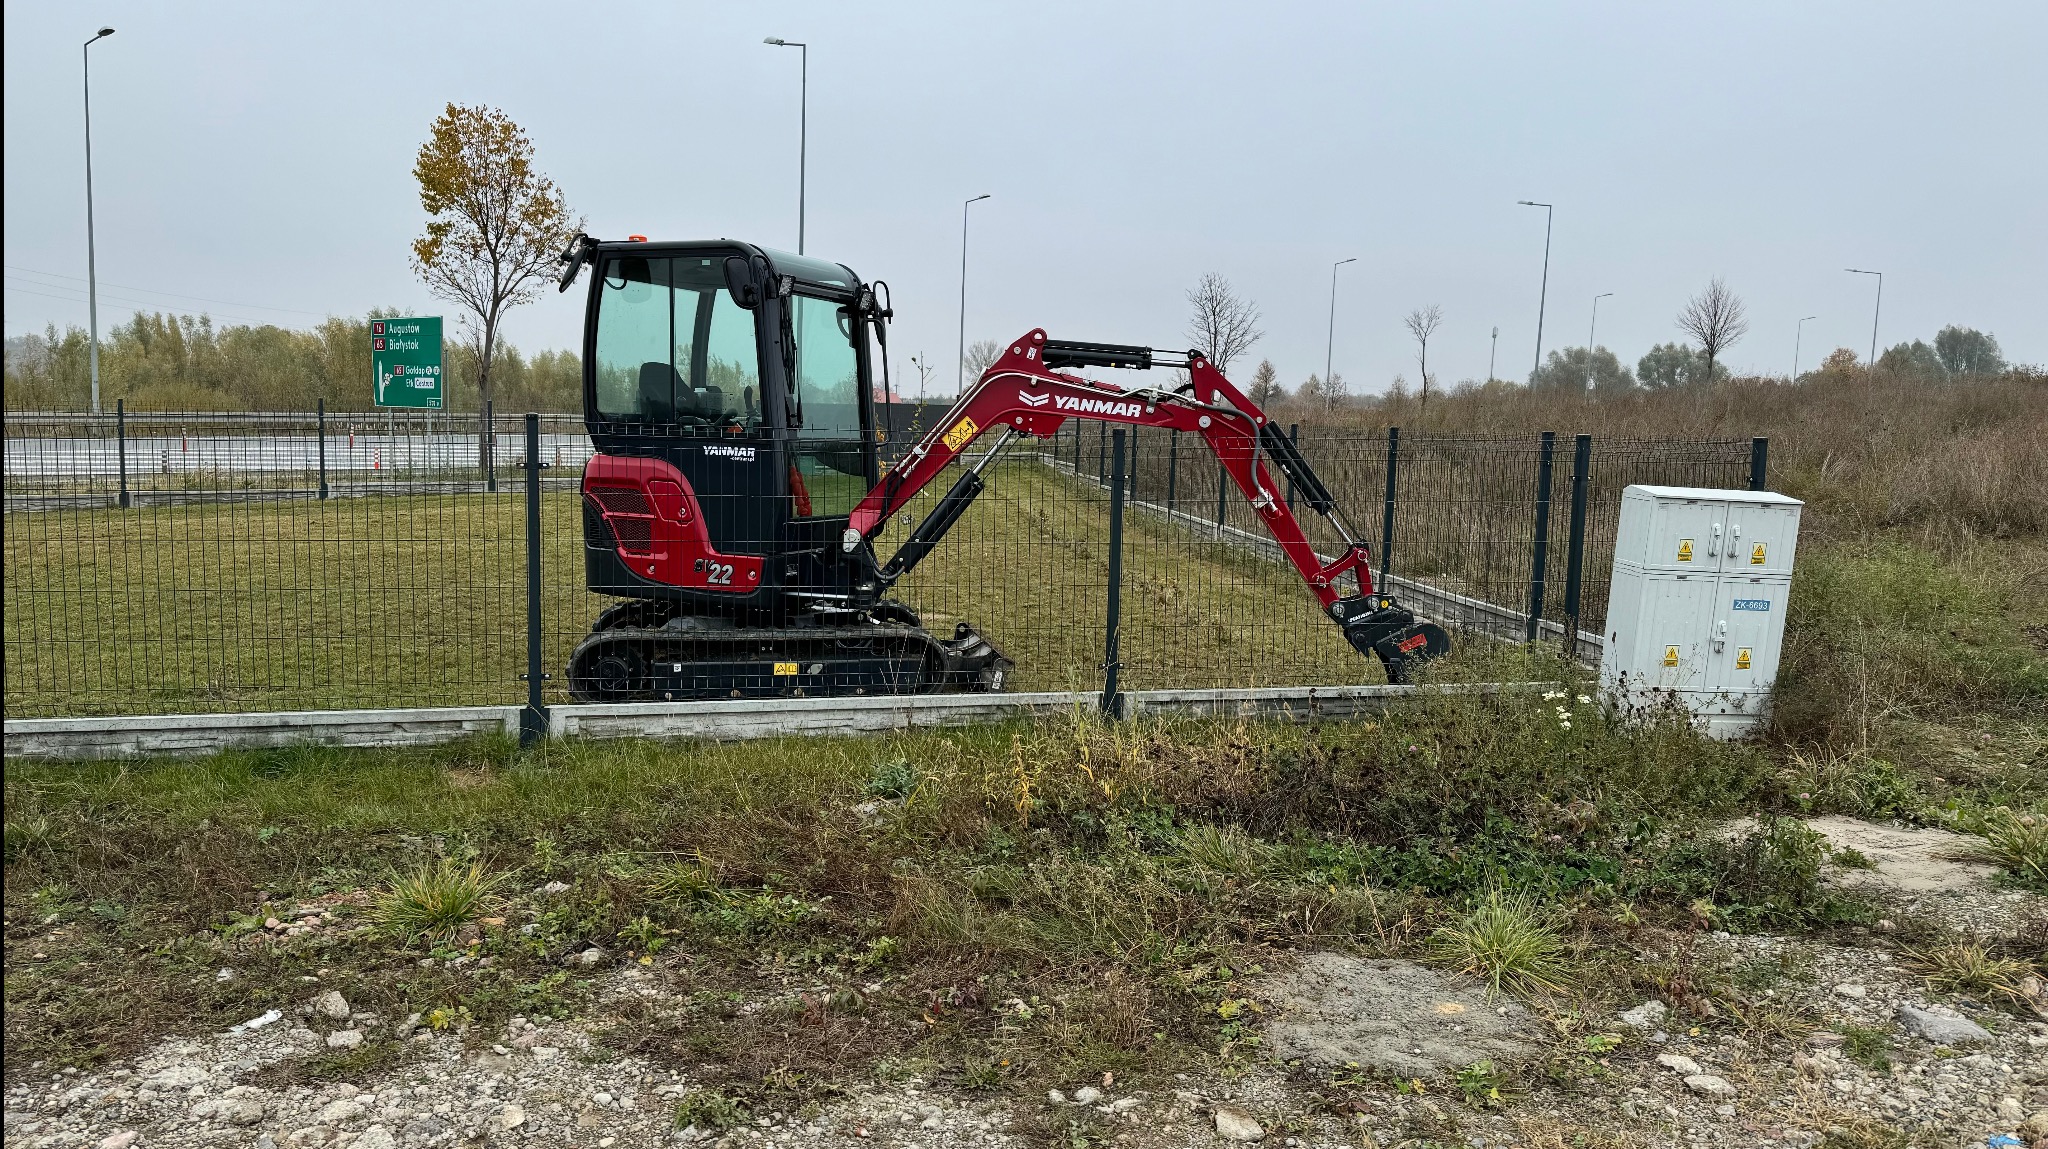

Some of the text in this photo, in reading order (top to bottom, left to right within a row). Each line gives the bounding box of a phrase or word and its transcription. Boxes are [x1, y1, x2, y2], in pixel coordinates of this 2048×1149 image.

[388, 322, 420, 337] Augustów
[389, 339, 419, 353] Białystok
[1054, 395, 1142, 418] YANMAR
[702, 445, 756, 457] YANMAR
